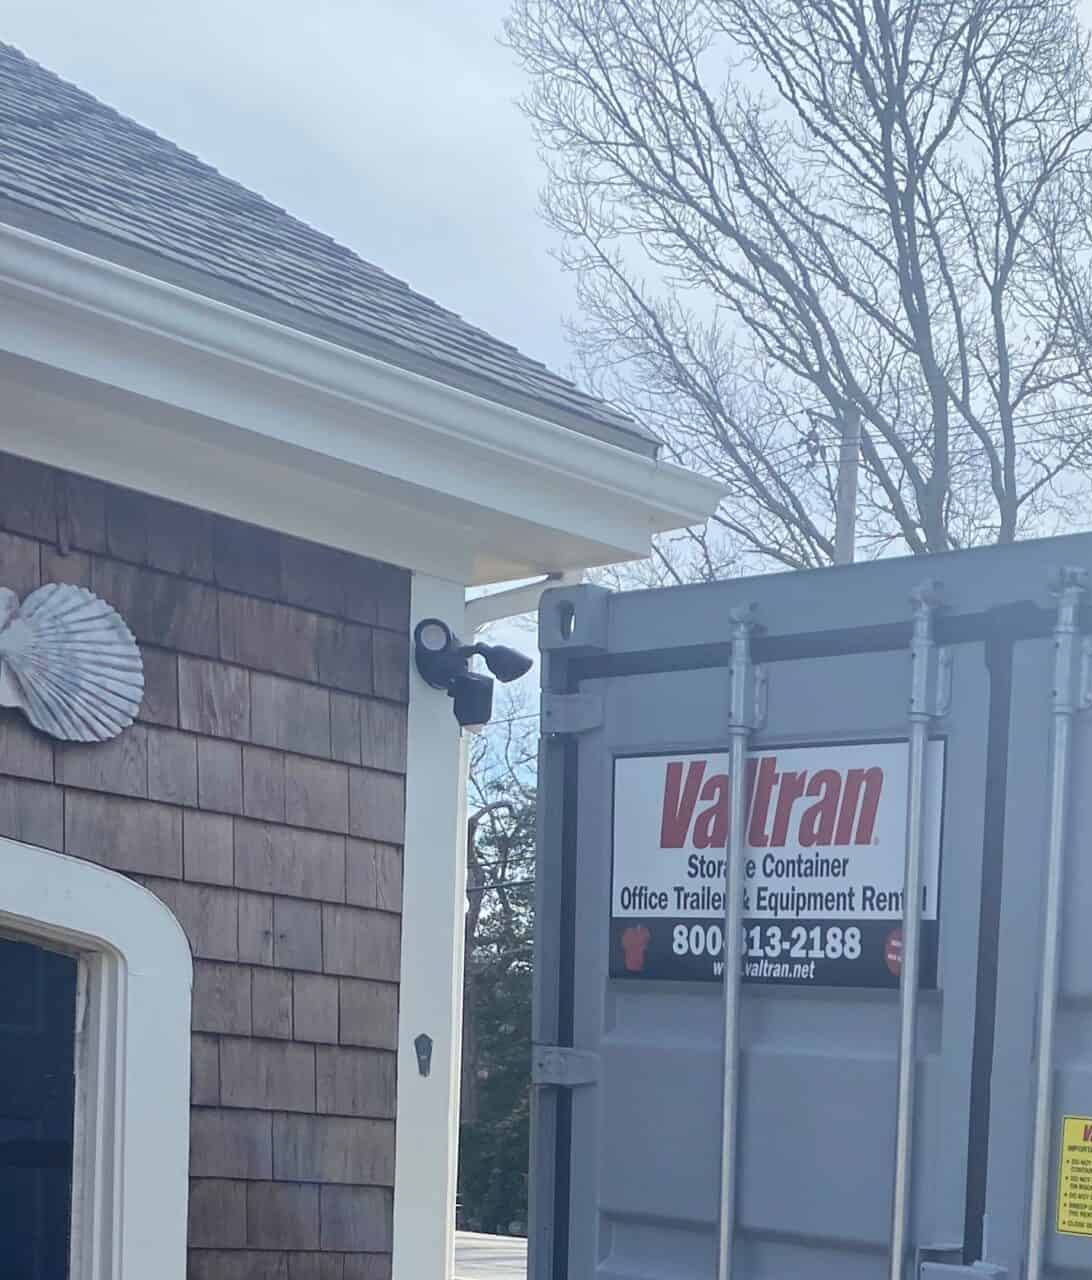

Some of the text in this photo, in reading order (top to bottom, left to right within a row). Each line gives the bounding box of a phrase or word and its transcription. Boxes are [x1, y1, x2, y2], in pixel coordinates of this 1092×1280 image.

[762, 851, 850, 878] Container
[620, 886, 669, 911] Office
[756, 885, 856, 917] Equipment
